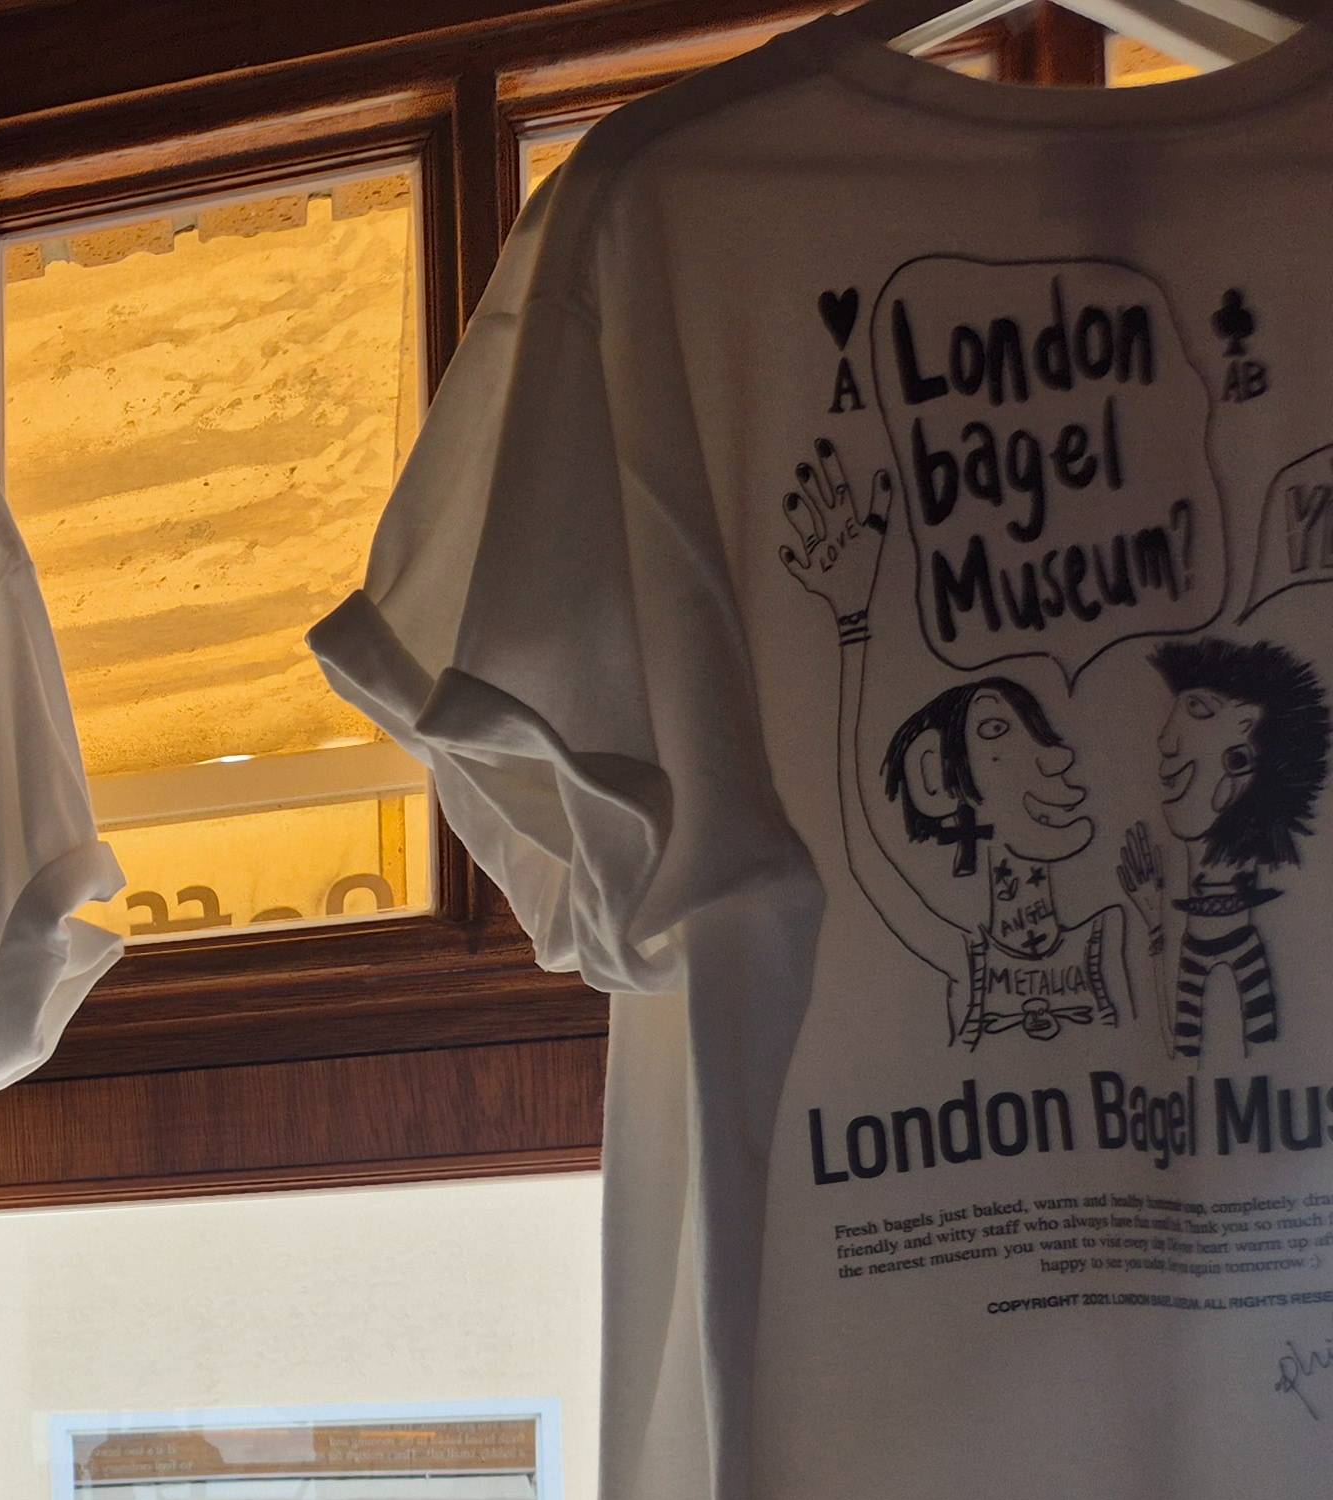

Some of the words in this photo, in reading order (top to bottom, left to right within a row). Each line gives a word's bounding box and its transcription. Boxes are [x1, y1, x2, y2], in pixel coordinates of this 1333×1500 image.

[892, 274, 1155, 406] London
[829, 357, 866, 413] A
[912, 395, 1123, 543] bagel
[933, 498, 1197, 643] Museum?
[1001, 898, 1056, 937] ANGEL
[809, 1079, 1074, 1186] London
[1090, 1070, 1198, 1170] Bagel
[1214, 1075, 1333, 1156] Mu
[835, 1222, 878, 1239] Fresh
[884, 1214, 934, 1234] bagels
[938, 1208, 967, 1226] just
[973, 1200, 1027, 1218] baked,
[1034, 1197, 1079, 1209] warm
[837, 1240, 899, 1259] friendly
[904, 1235, 932, 1249] and
[937, 1228, 976, 1243] witty
[982, 1219, 1021, 1237] staff
[1023, 1217, 1058, 1231] who
[839, 1266, 862, 1278] the
[869, 1256, 925, 1274] nearest
[931, 1246, 998, 1265] museum
[1004, 1242, 1033, 1259] you
[1040, 1238, 1077, 1251] want
[1040, 1258, 1086, 1275] happy
[1091, 1258, 1103, 1268] to
[987, 1294, 1078, 1314] COPYRIGHT
